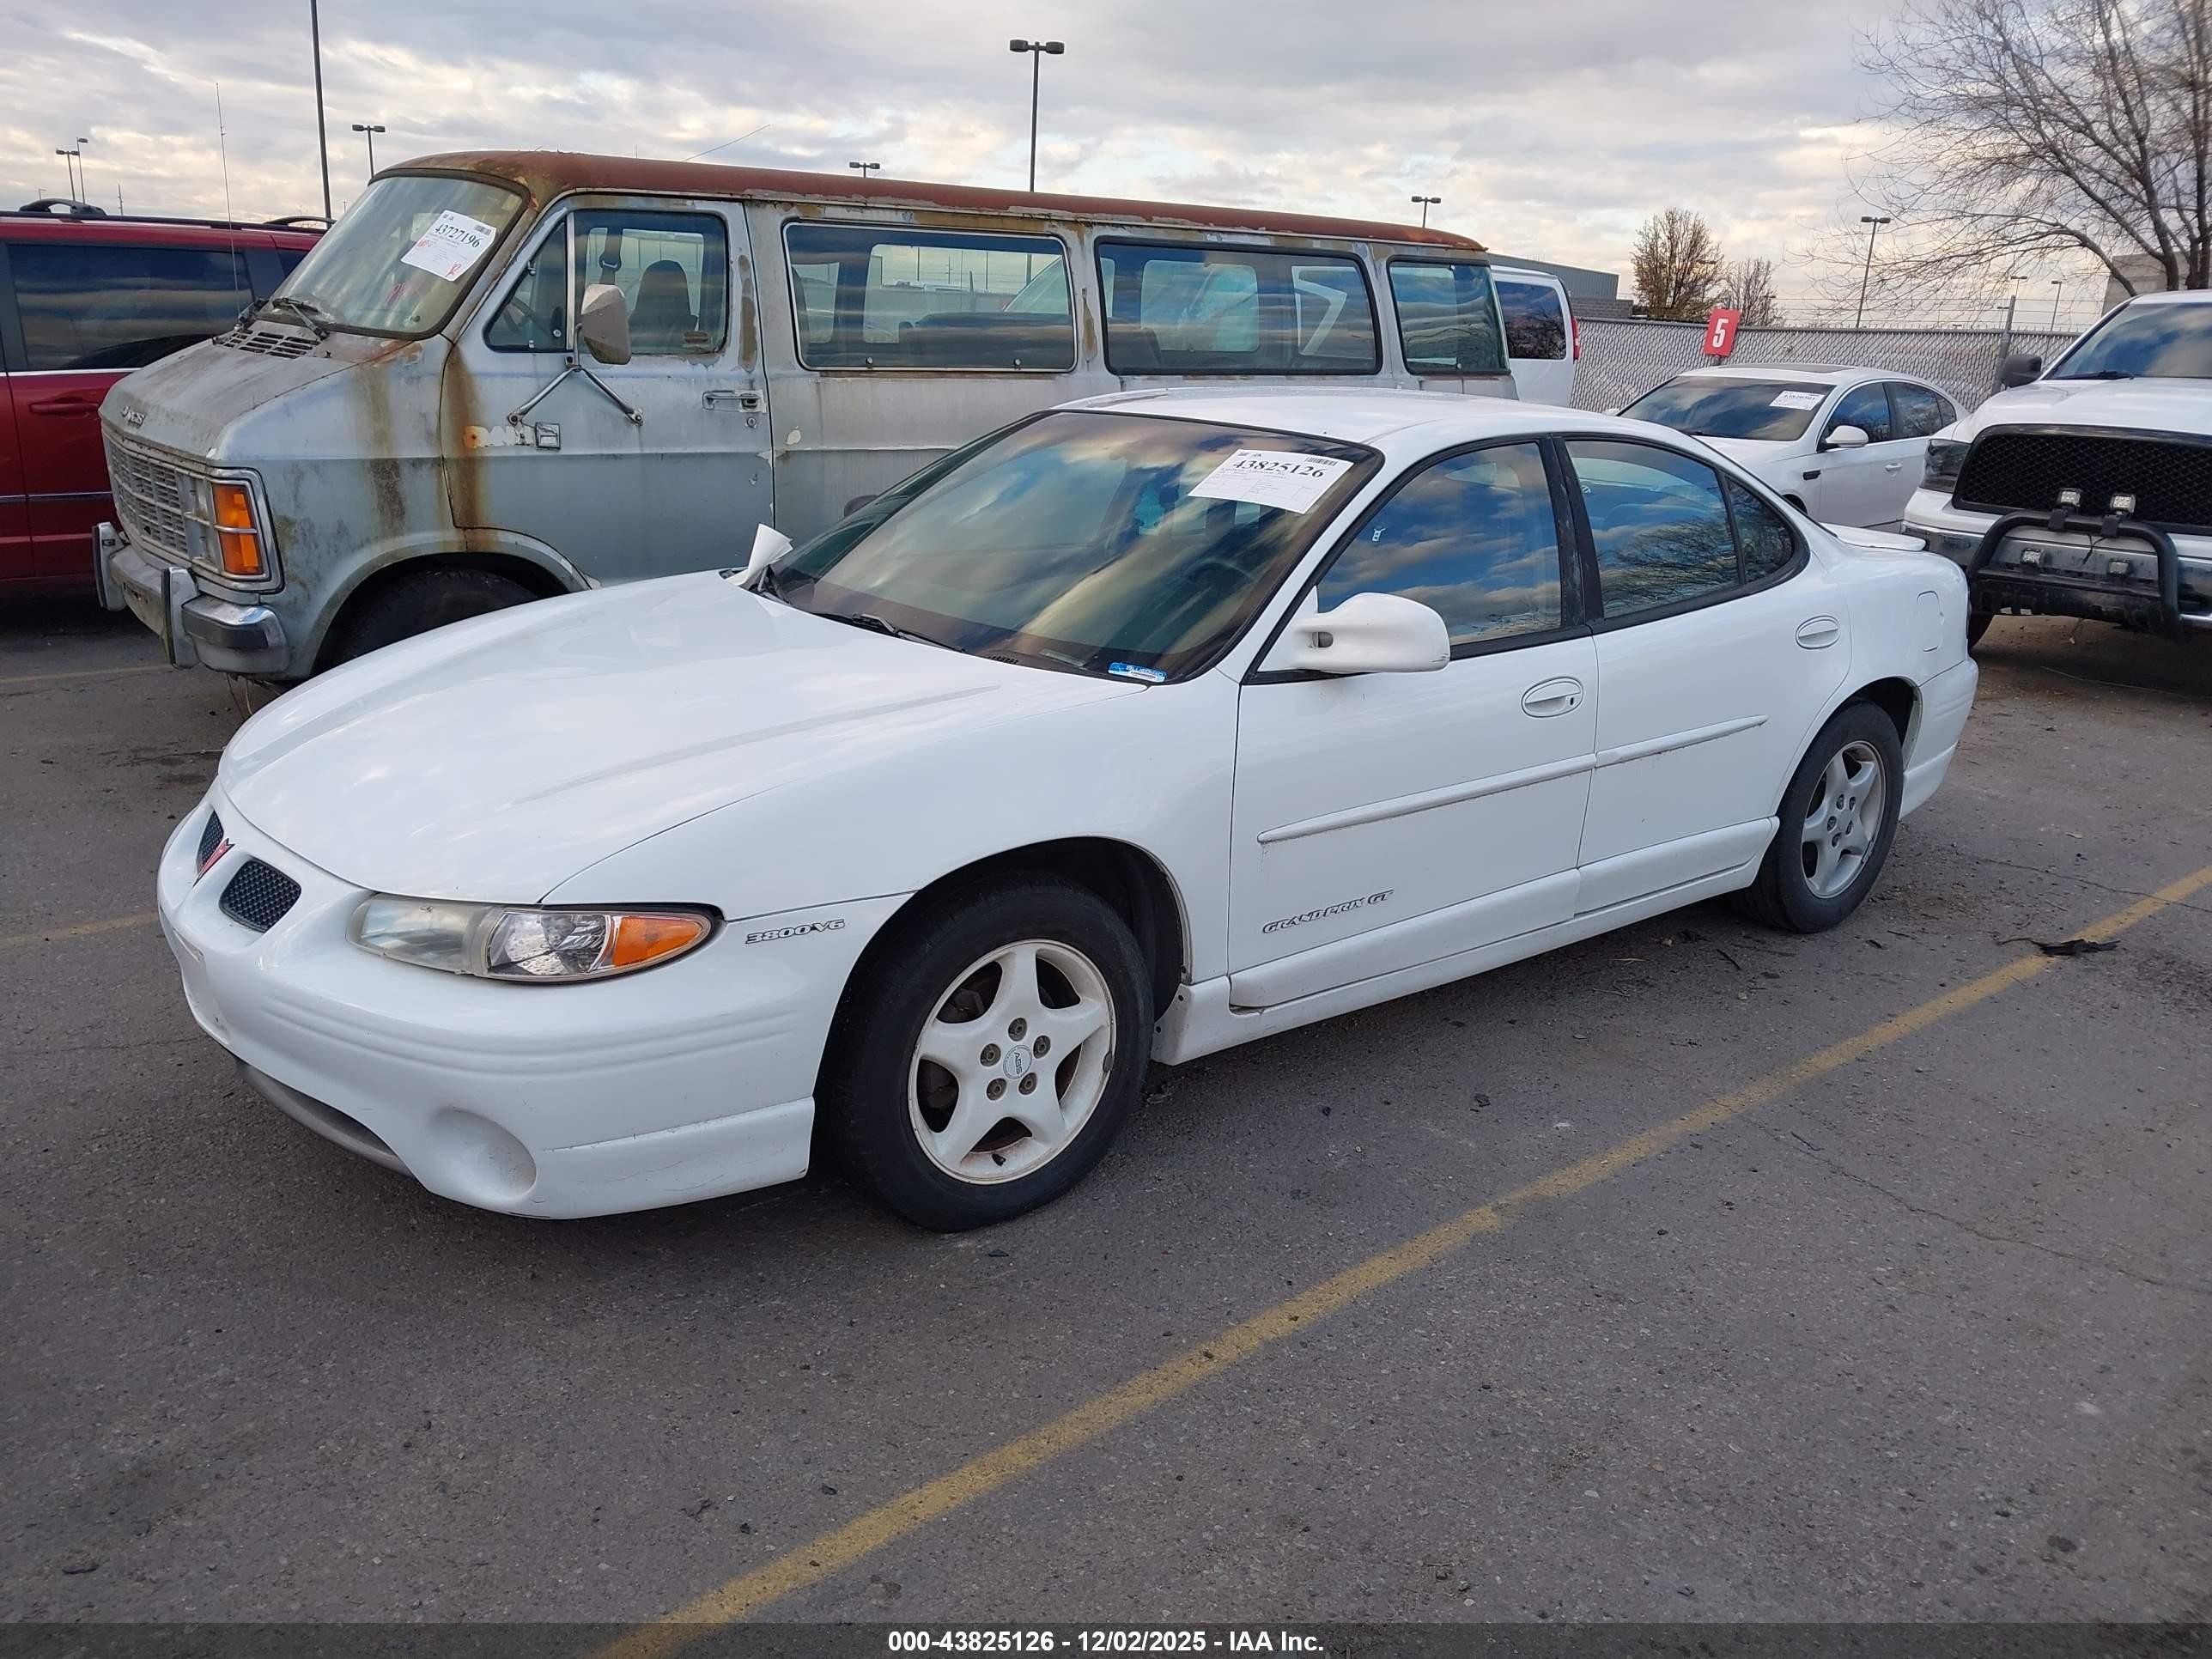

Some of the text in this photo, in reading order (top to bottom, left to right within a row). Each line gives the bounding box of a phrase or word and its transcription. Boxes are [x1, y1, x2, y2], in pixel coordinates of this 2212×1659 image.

[434, 223, 483, 248] 43727196
[1712, 319, 1729, 348] 5
[1232, 459, 1326, 478] 43825126
[1262, 889, 1395, 933] GRAND PRIX GT
[1013, 1052, 1023, 1074] ABS
